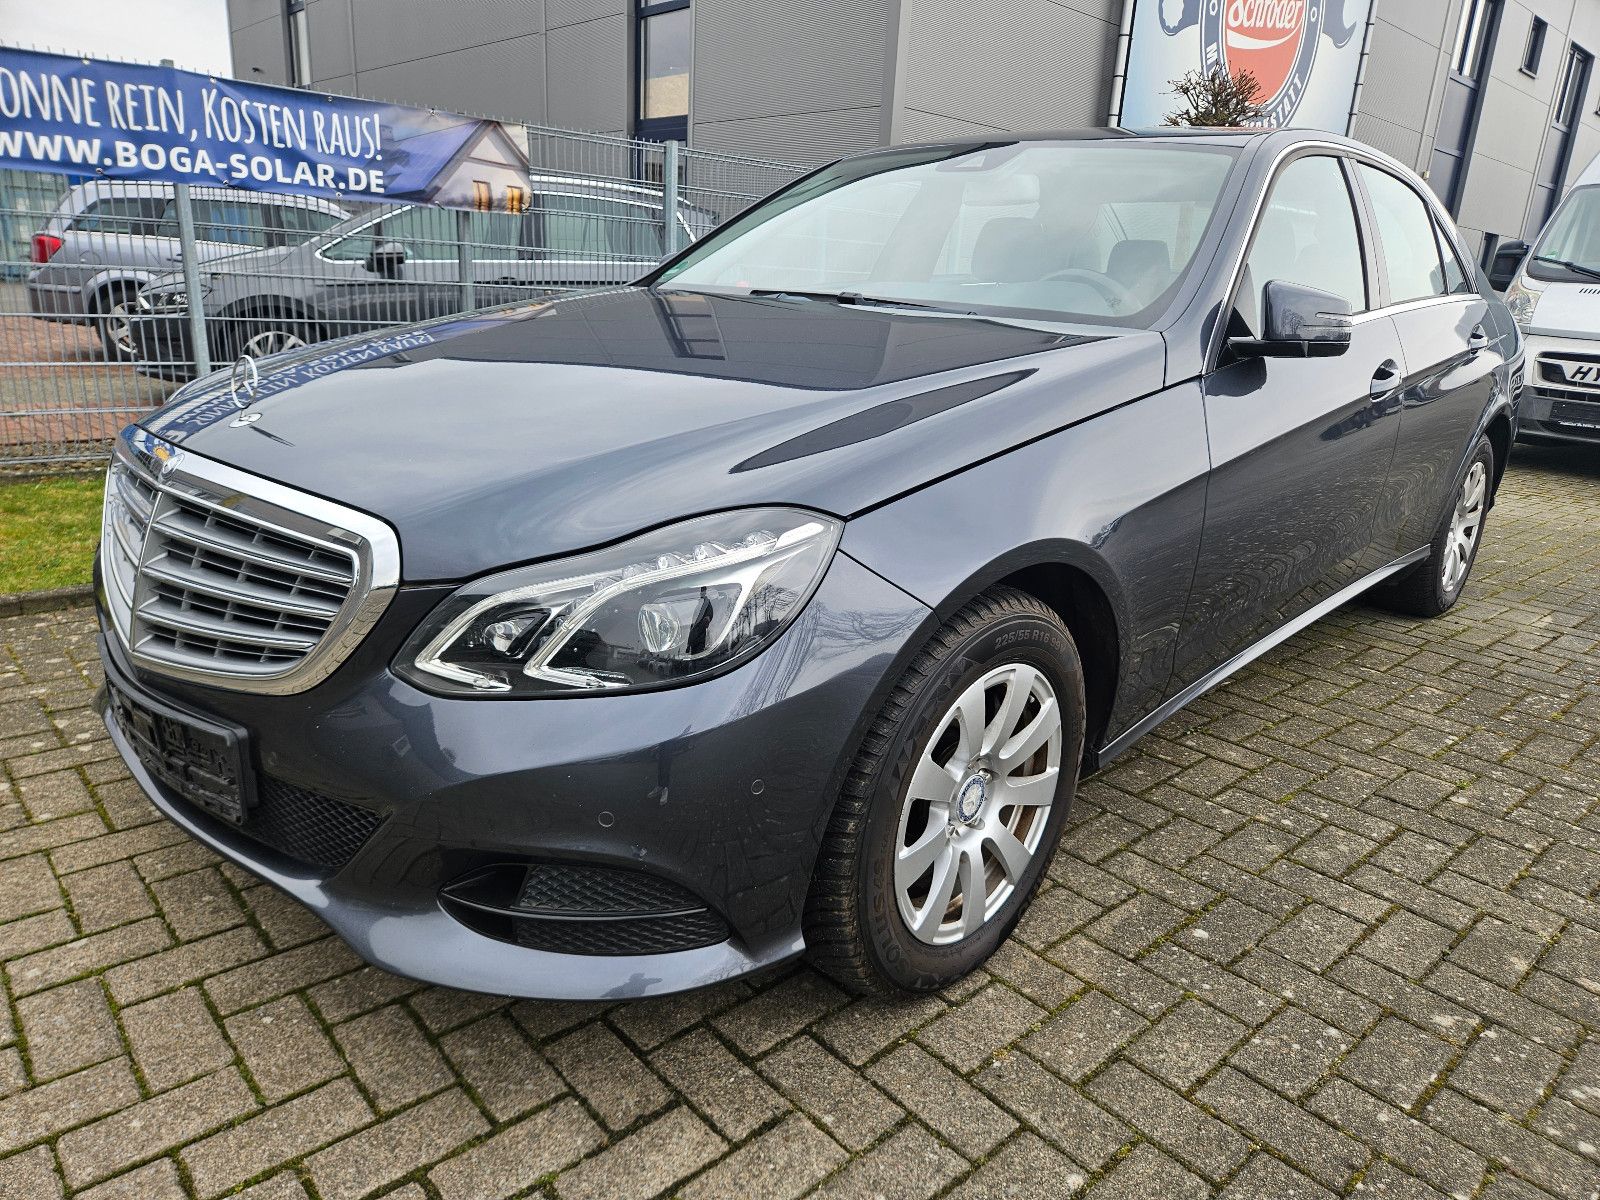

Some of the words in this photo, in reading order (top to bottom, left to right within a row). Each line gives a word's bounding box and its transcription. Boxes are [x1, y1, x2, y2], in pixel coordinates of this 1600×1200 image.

[105, 80, 198, 142] REIN,
[202, 88, 307, 151] KOSTEN
[312, 113, 383, 161] RAUS!
[0, 130, 385, 194] WWW.BOGA-SOLAR.DE
[994, 629, 1031, 650] 225/55
[1032, 629, 1050, 643] R16
